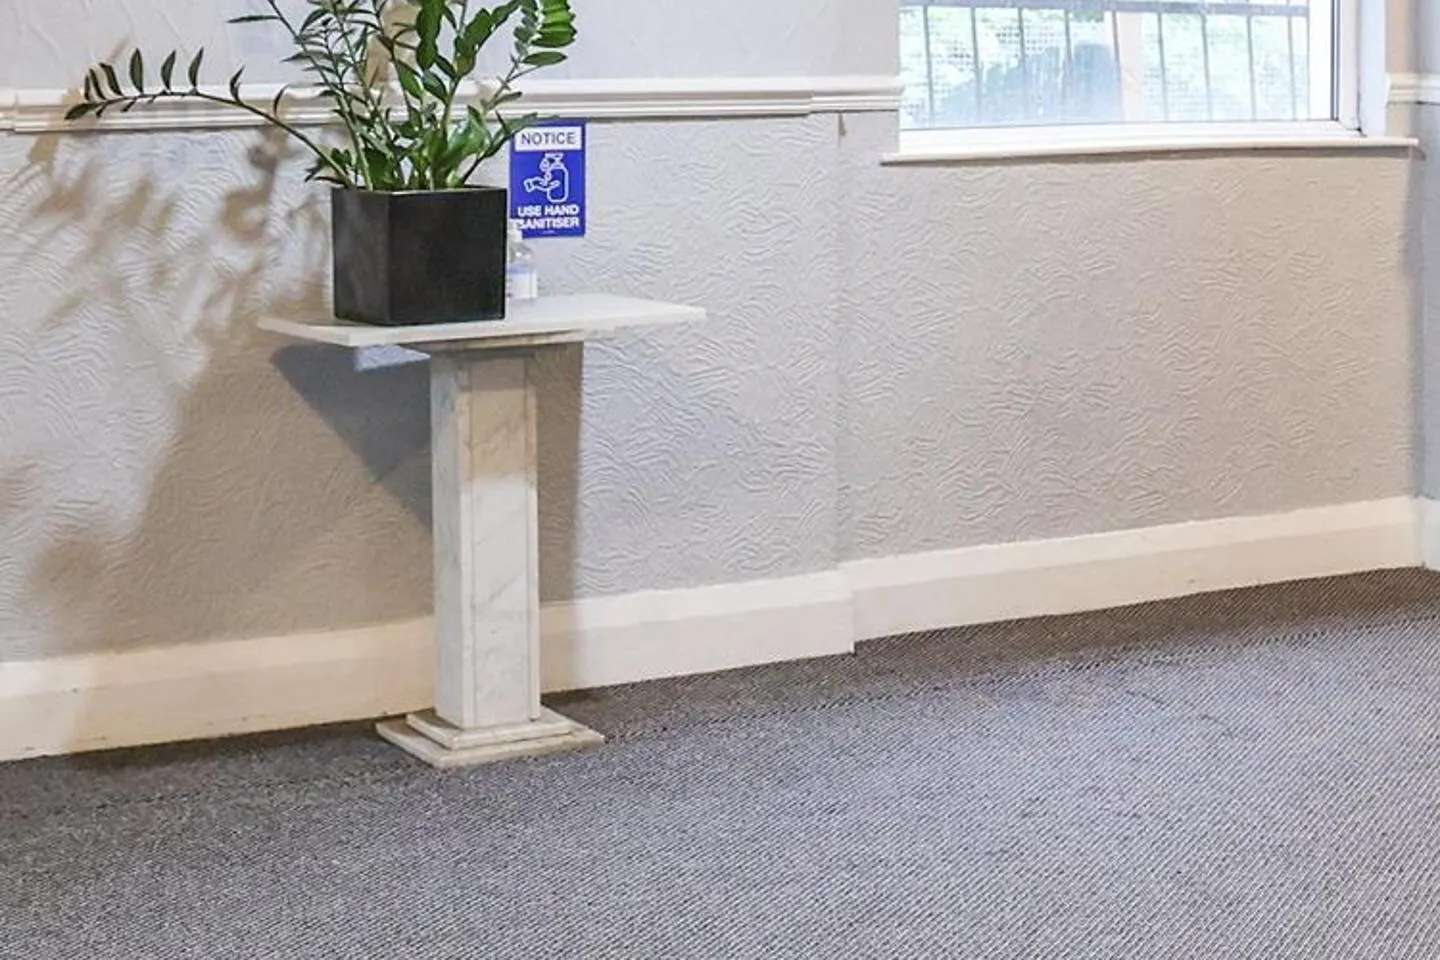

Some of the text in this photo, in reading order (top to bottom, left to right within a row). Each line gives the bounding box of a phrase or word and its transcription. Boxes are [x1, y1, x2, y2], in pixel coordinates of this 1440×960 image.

[521, 132, 576, 145] NOTICE
[517, 203, 579, 217] USE HAND
